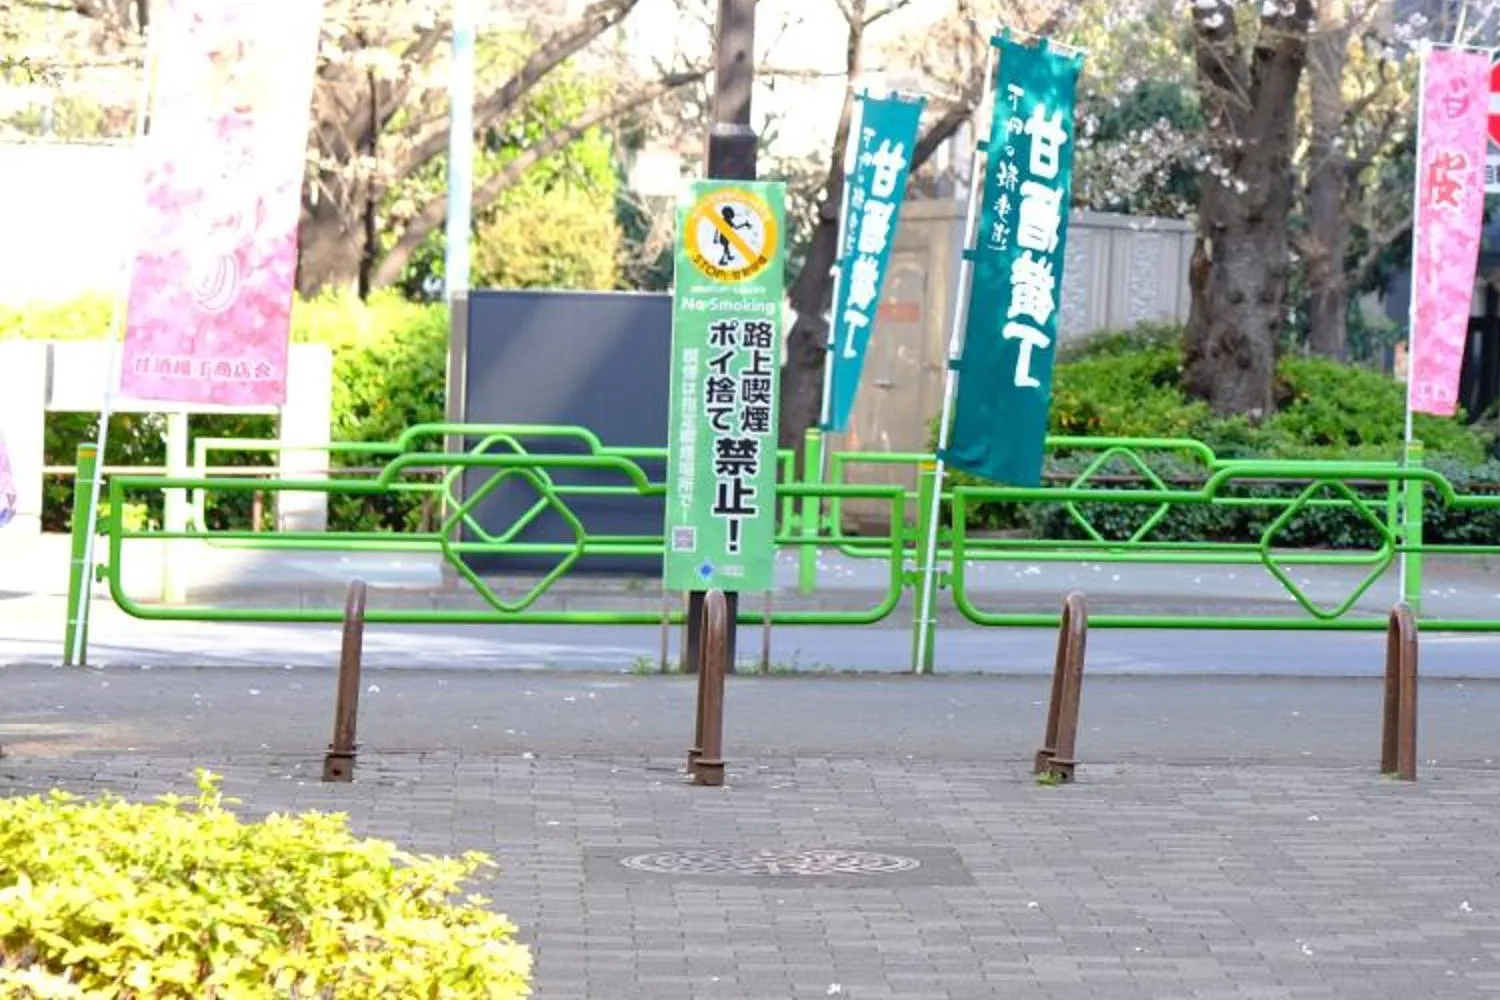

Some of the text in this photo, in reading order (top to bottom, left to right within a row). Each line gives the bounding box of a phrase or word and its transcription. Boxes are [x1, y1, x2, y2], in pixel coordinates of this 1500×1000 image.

[1002, 103, 1067, 388] 甘酒横丁
[682, 297, 775, 315] No Smoking
[704, 319, 738, 432] ポイ捨て
[740, 322, 772, 433] 路上喫煙
